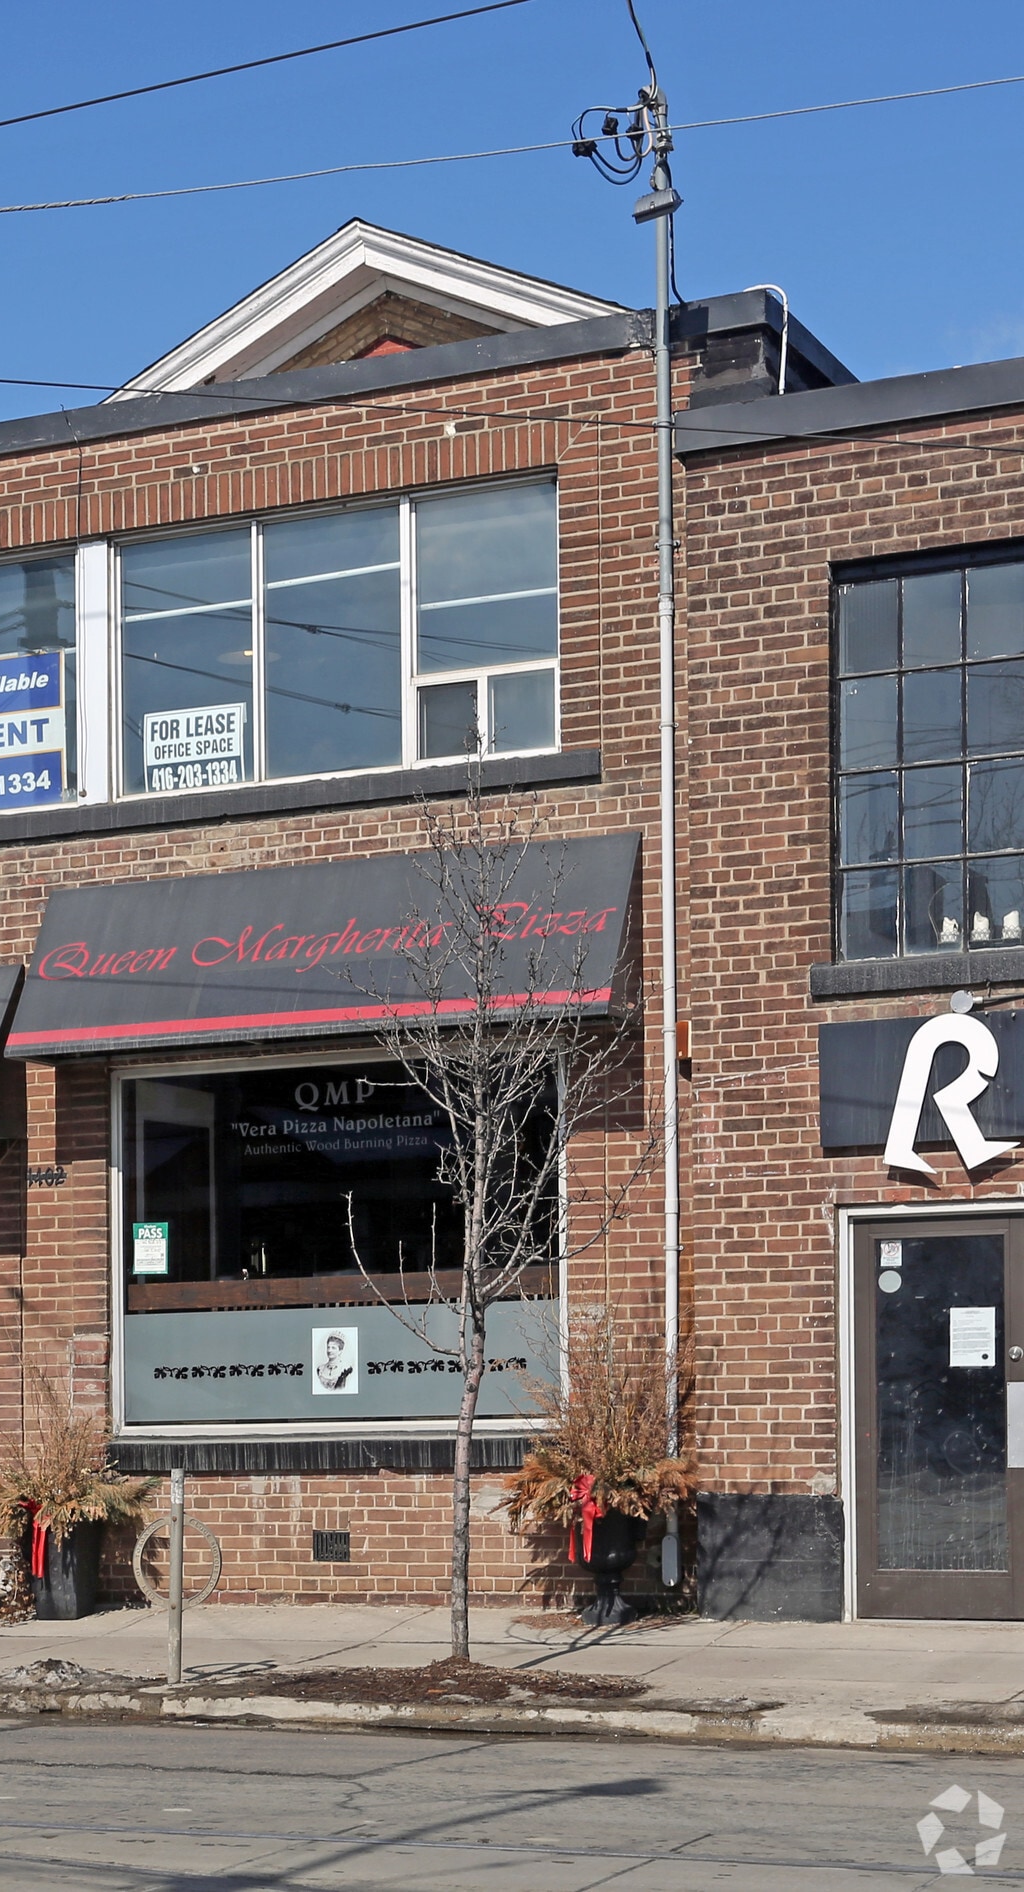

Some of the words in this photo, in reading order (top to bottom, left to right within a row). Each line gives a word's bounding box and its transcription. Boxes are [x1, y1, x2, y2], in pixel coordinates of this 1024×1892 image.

[150, 719, 180, 742] FOR
[186, 712, 236, 738] LEASE
[154, 742, 191, 760] OFFICE
[195, 737, 234, 756] SPACE
[151, 760, 238, 791] 416-203-1334
[38, 941, 177, 982] Queen
[191, 916, 453, 973] Margherita
[476, 900, 619, 942] Pizza
[294, 1079, 375, 1112] QMP
[231, 1121, 277, 1138] "Vera
[283, 1119, 327, 1135] Pizza
[333, 1110, 441, 1134] Napoletana"
[244, 1142, 302, 1156] Authentic
[305, 1139, 340, 1152] Wood
[344, 1136, 393, 1150] Burning
[396, 1134, 428, 1146] Pizza
[138, 1227, 163, 1239] PASS
